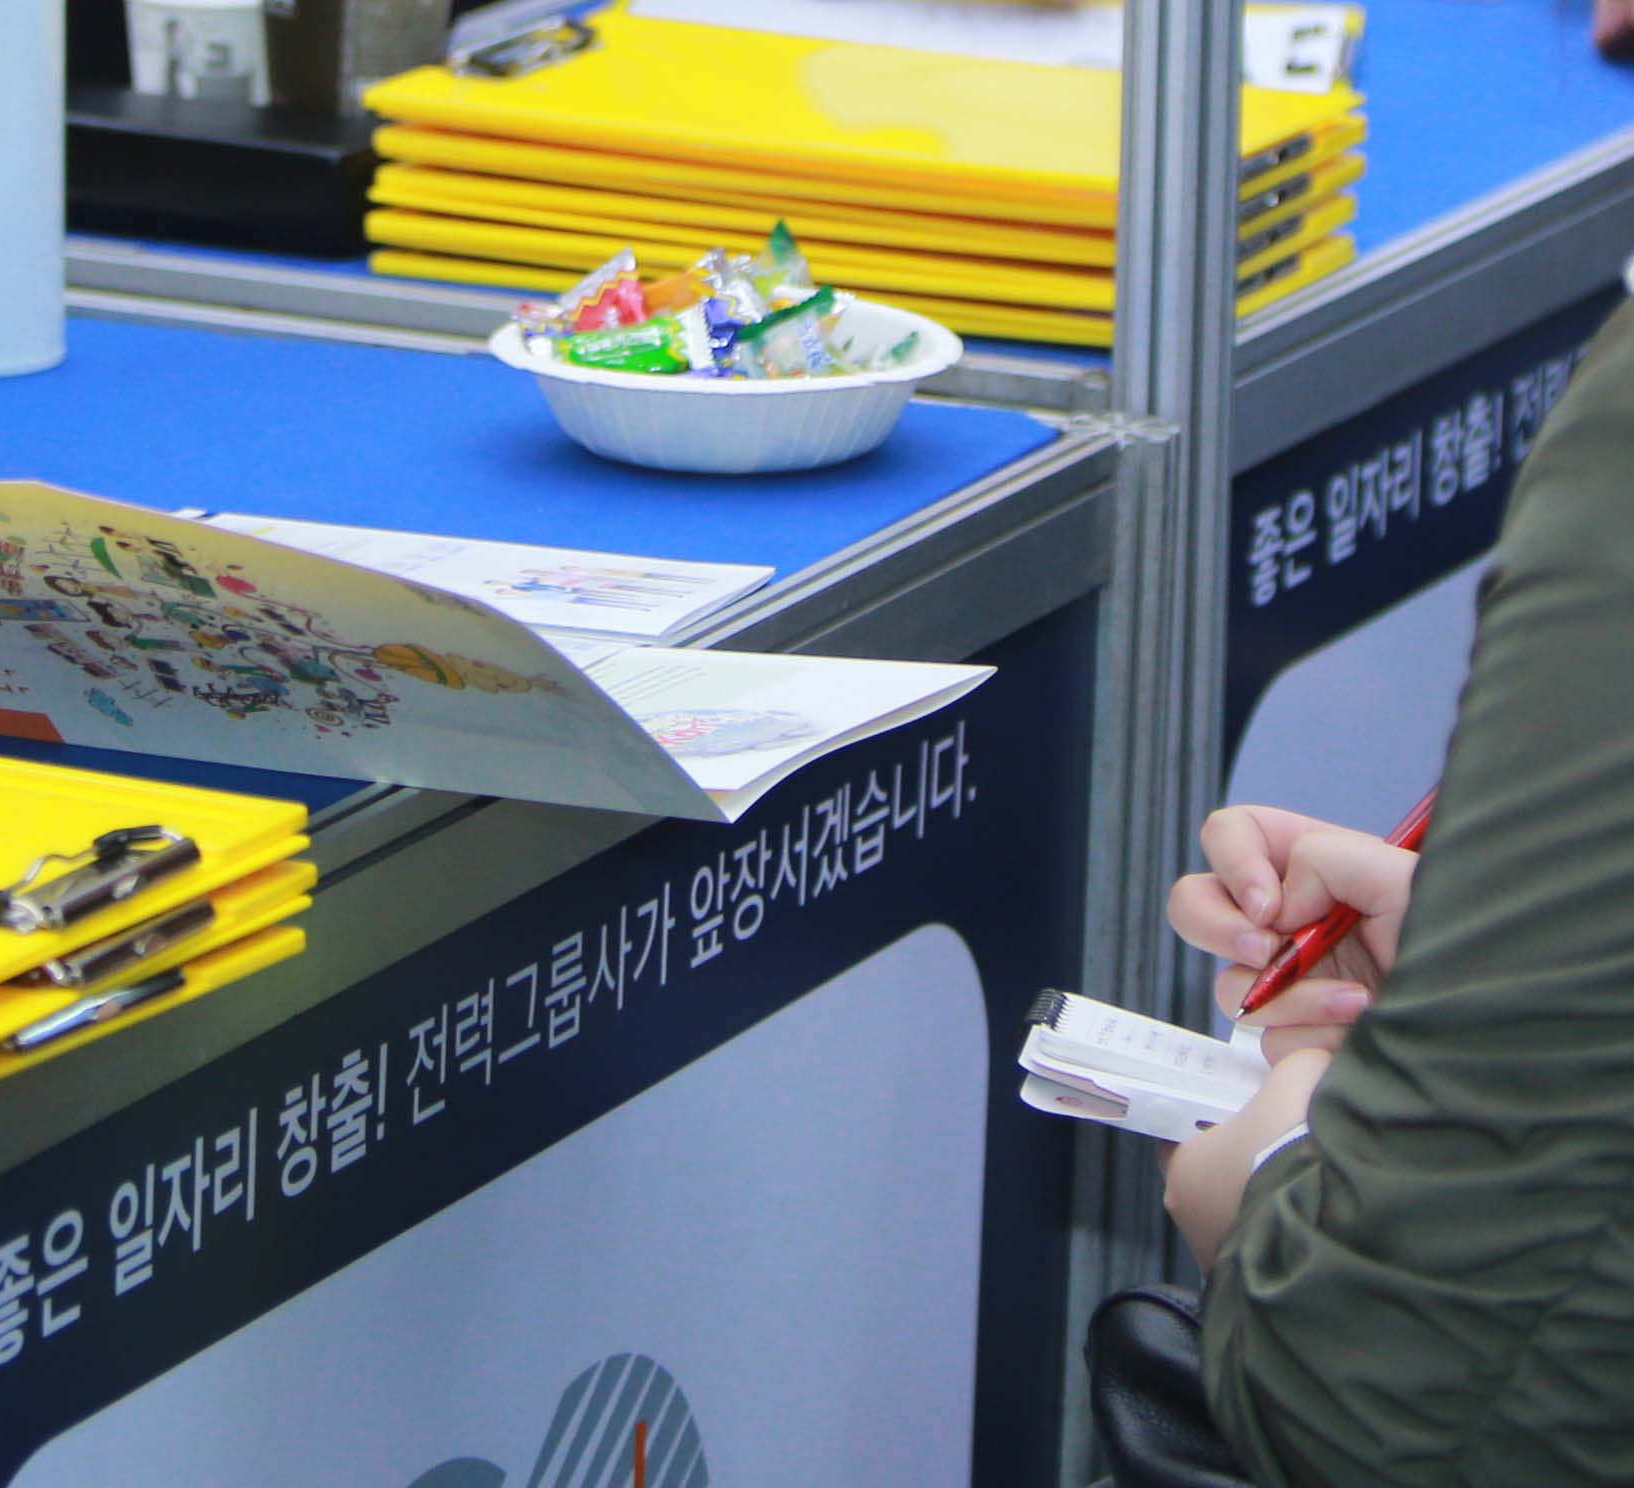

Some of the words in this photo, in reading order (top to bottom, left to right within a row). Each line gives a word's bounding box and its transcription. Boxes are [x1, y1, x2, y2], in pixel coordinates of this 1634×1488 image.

[1249, 488, 1317, 607] 좋은
[1325, 430, 1423, 565] 일자리
[1429, 392, 1504, 507] 창출!
[108, 1106, 259, 1297] 일자리
[276, 1042, 389, 1198] 창출!
[405, 881, 677, 1126] 전력그룹사가
[689, 720, 977, 970] 앞장서겠습니다.
